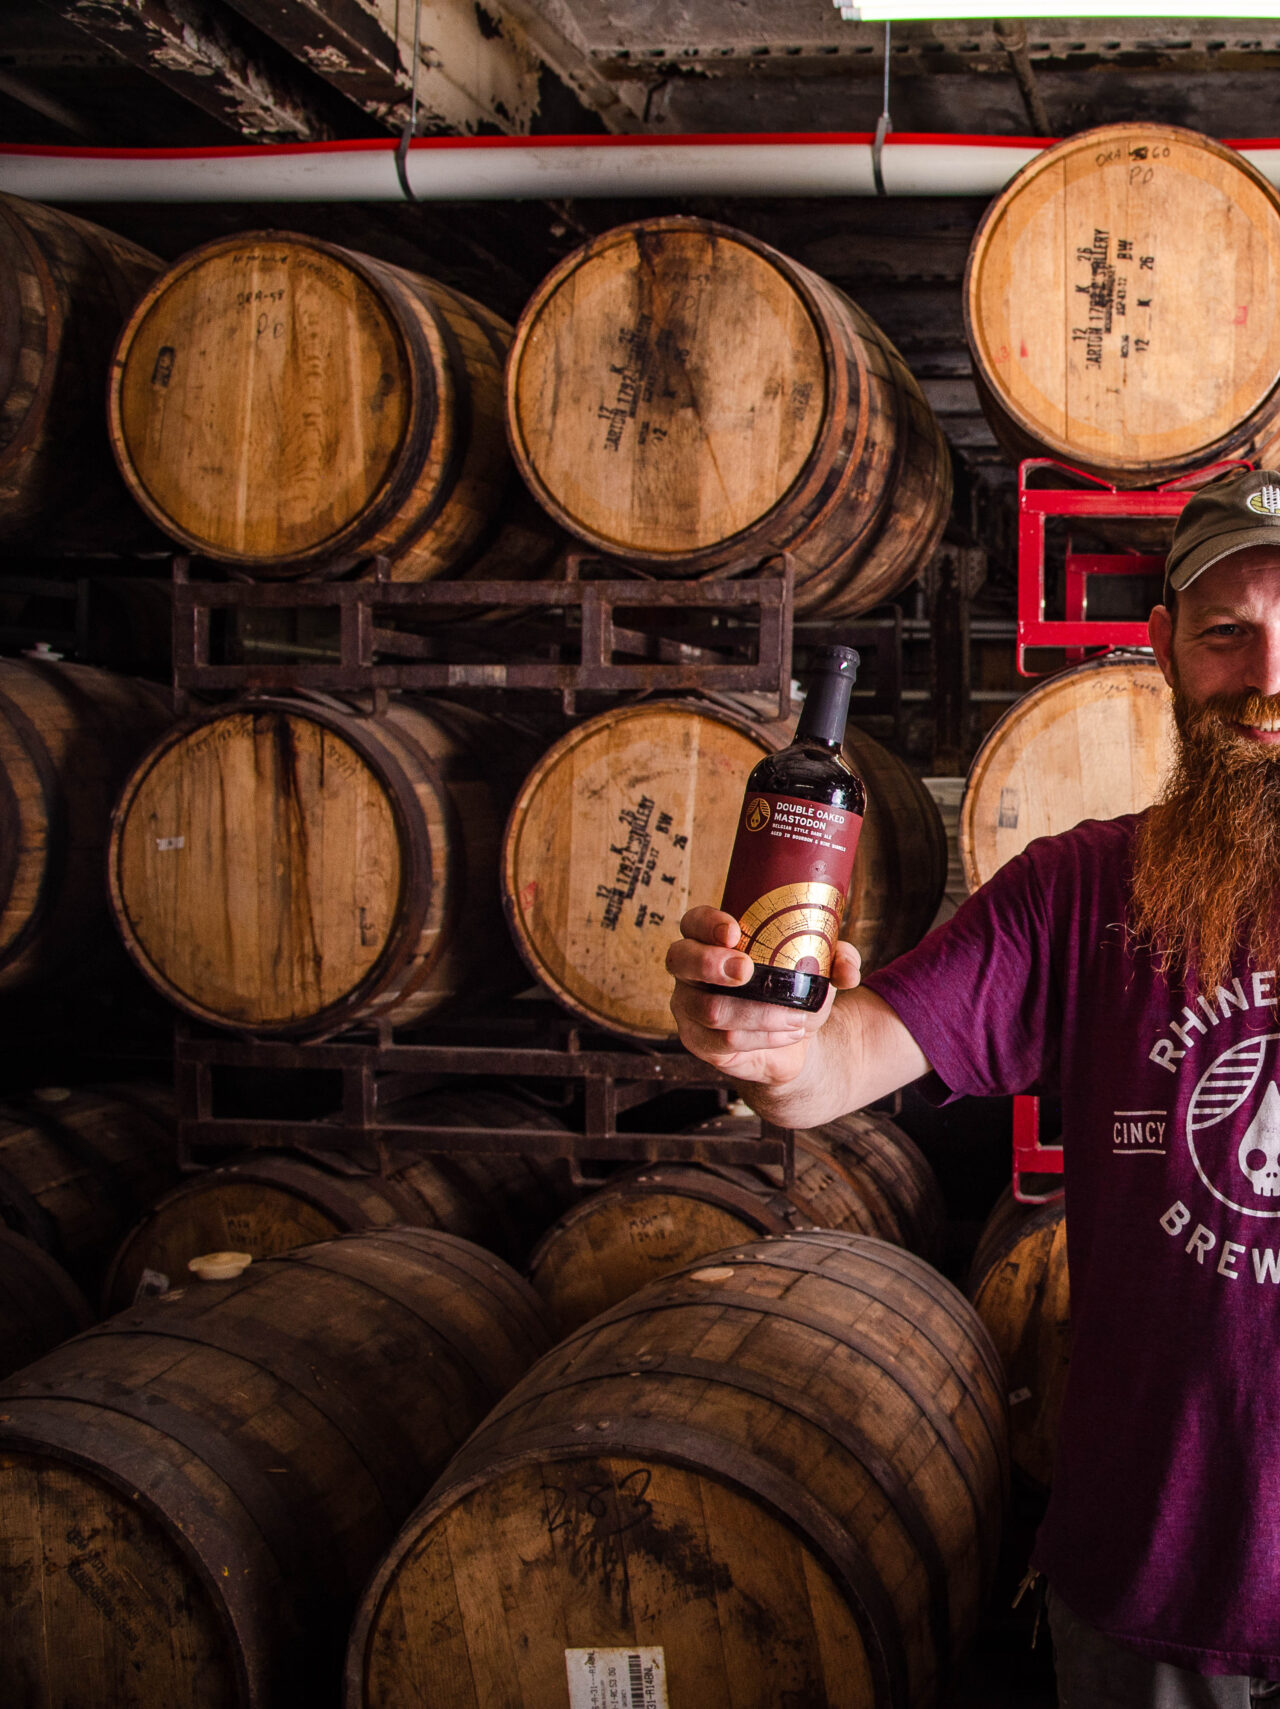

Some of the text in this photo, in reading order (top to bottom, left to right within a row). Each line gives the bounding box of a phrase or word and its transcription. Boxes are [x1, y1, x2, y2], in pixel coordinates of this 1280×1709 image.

[1075, 285, 1090, 294] K
[1135, 256, 1155, 352] 12 K 26
[1072, 327, 1087, 341] 12
[598, 404, 615, 420] 12
[610, 364, 625, 375] K
[617, 374, 636, 405] 1792
[655, 811, 673, 834] BW
[774, 813, 827, 831] MASTODON
[776, 802, 846, 824] DOUBLE OAKED
[616, 854, 636, 885] 1792
[649, 833, 688, 926] 12 K 26
[596, 884, 612, 898] 12
[1113, 1119, 1167, 1145] CINCY
[539, 1468, 652, 1553] 283
